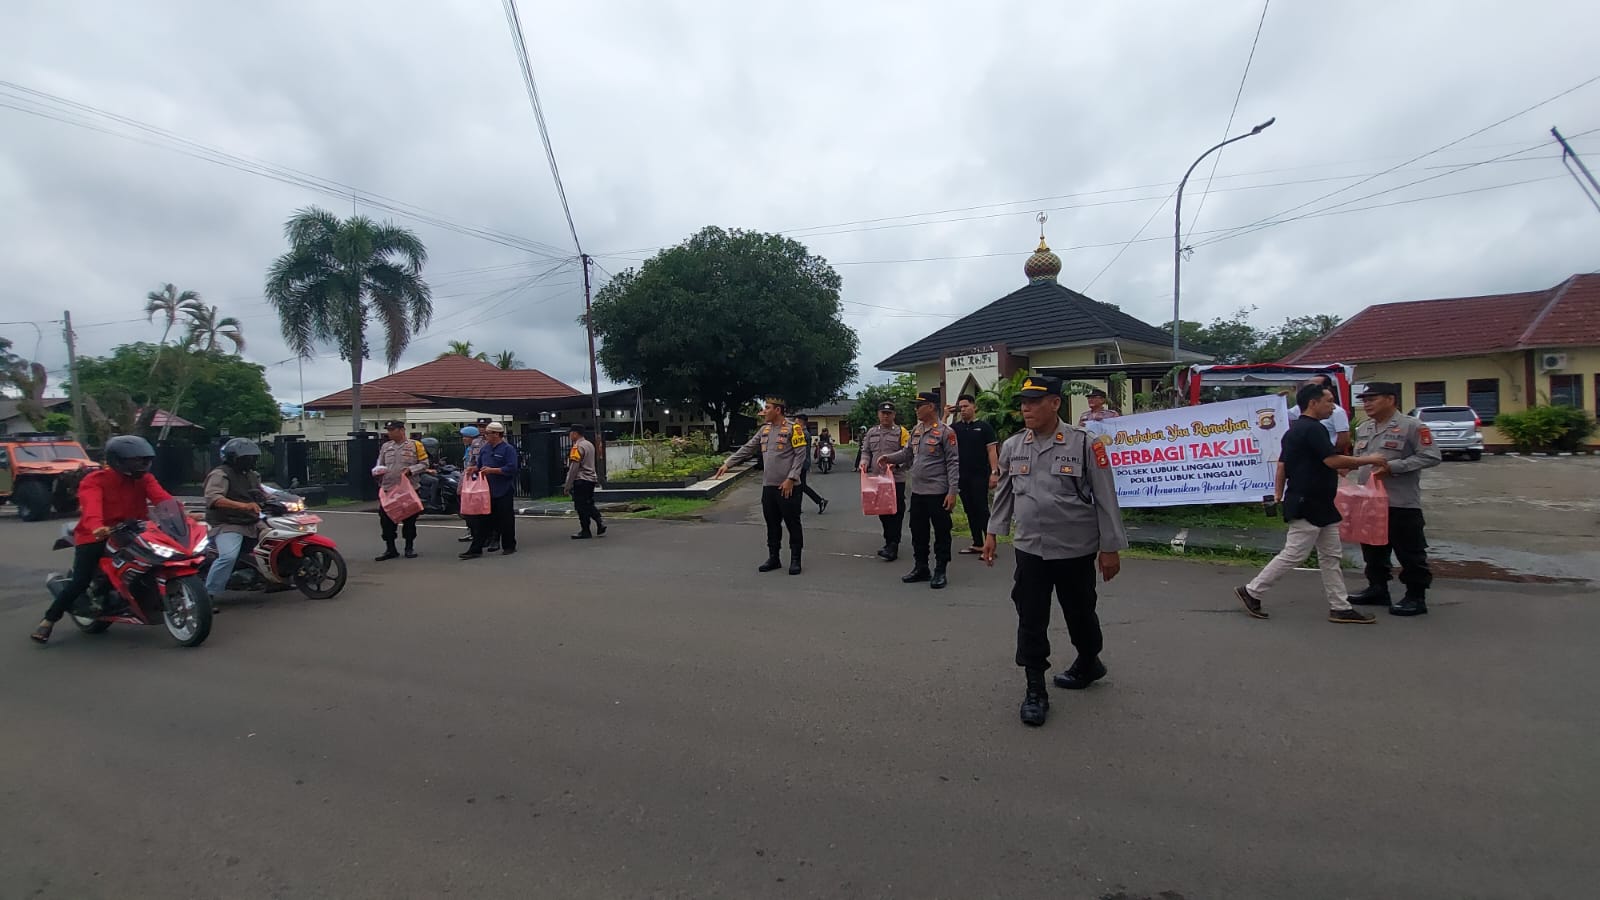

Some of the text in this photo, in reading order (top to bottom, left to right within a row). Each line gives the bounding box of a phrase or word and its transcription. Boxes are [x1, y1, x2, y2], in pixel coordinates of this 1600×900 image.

[1115, 417, 1251, 445] Marhaban Yaa Ramadhan
[1055, 455, 1080, 463] POLRI
[1111, 445, 1184, 466] BERBAGI
[1189, 438, 1259, 459] TAKJIL
[1117, 459, 1257, 476] POLSEK LUBUK LINGGAU TIMUR
[1130, 470, 1242, 484] POLRES LUBUK LINGGAU
[1202, 480, 1237, 494] Ibadah
[1240, 478, 1274, 489] Puasa
